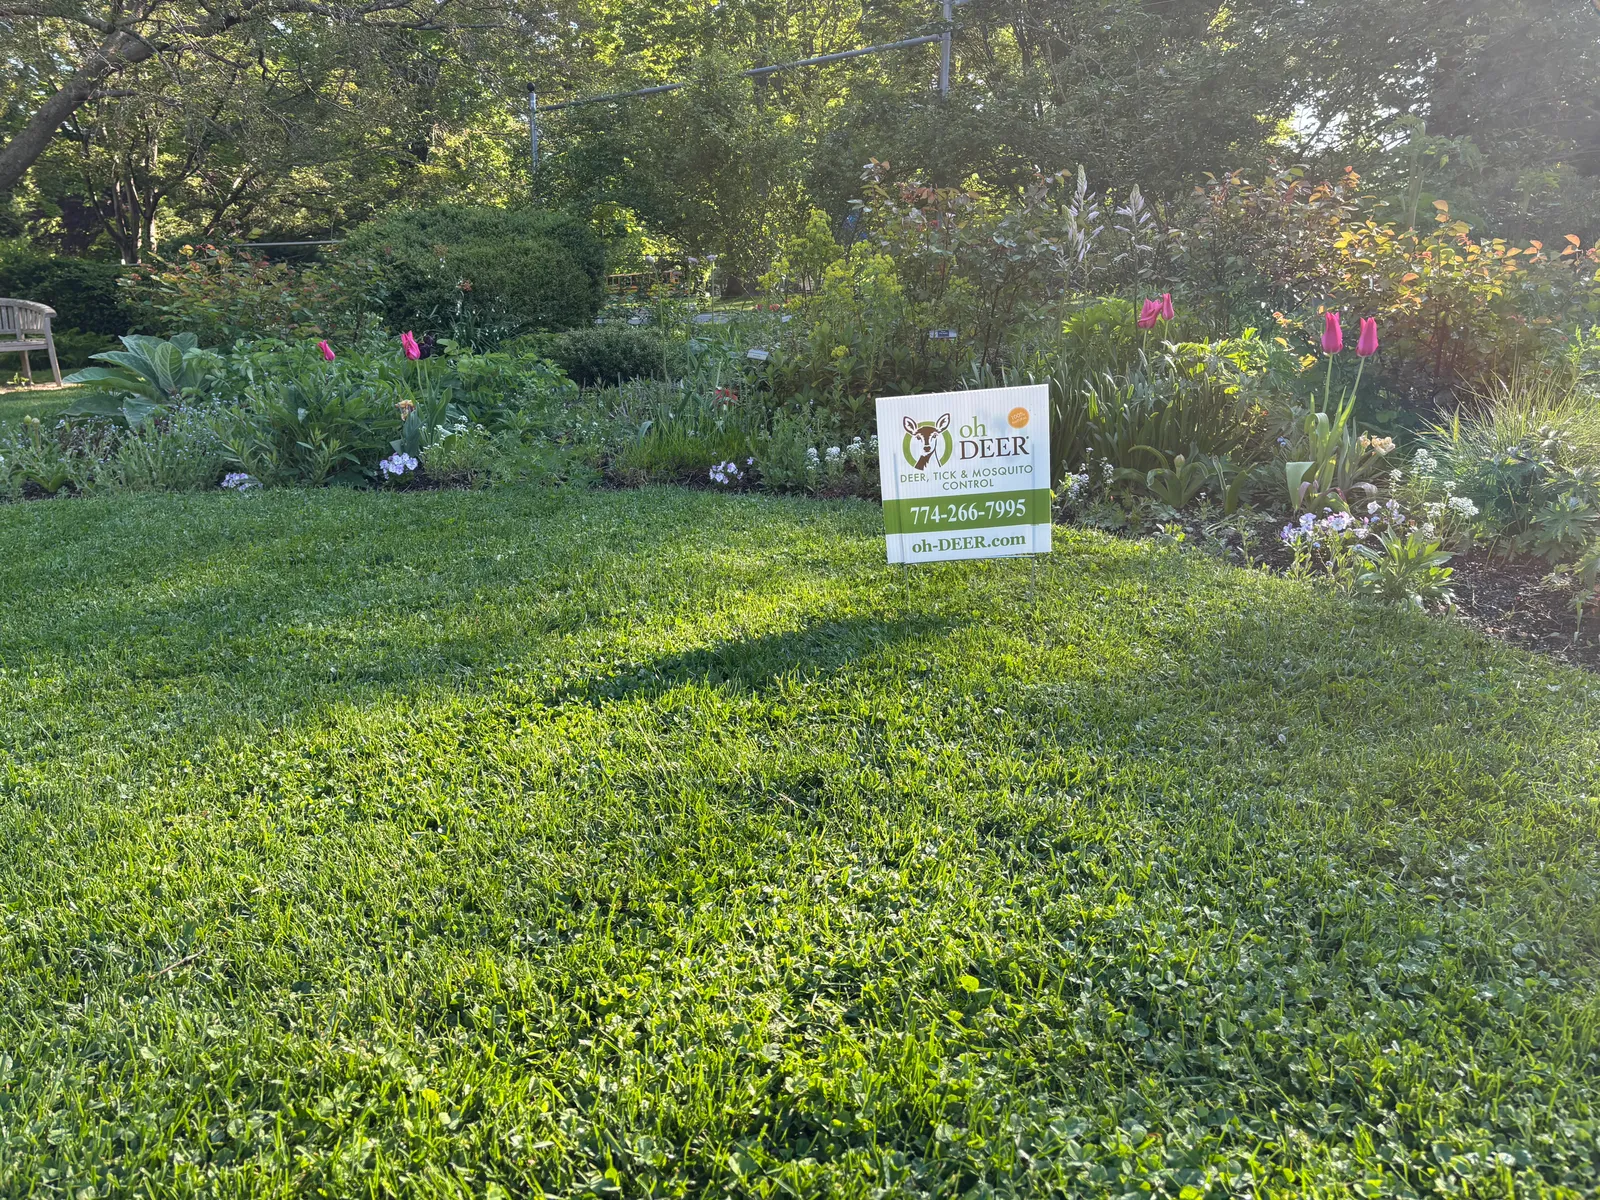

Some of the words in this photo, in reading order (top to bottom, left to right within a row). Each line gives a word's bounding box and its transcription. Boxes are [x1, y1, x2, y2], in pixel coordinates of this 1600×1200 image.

[959, 416, 987, 438] oh
[959, 436, 1029, 460] DEER
[900, 473, 930, 484] DEER,
[933, 470, 957, 480] TICK
[960, 469, 969, 479] &
[972, 464, 1033, 478] MOSQUITO
[942, 479, 994, 491] CONTROL
[910, 498, 1026, 525] 774-266-7995
[912, 534, 1026, 554] oh-DEER.com
